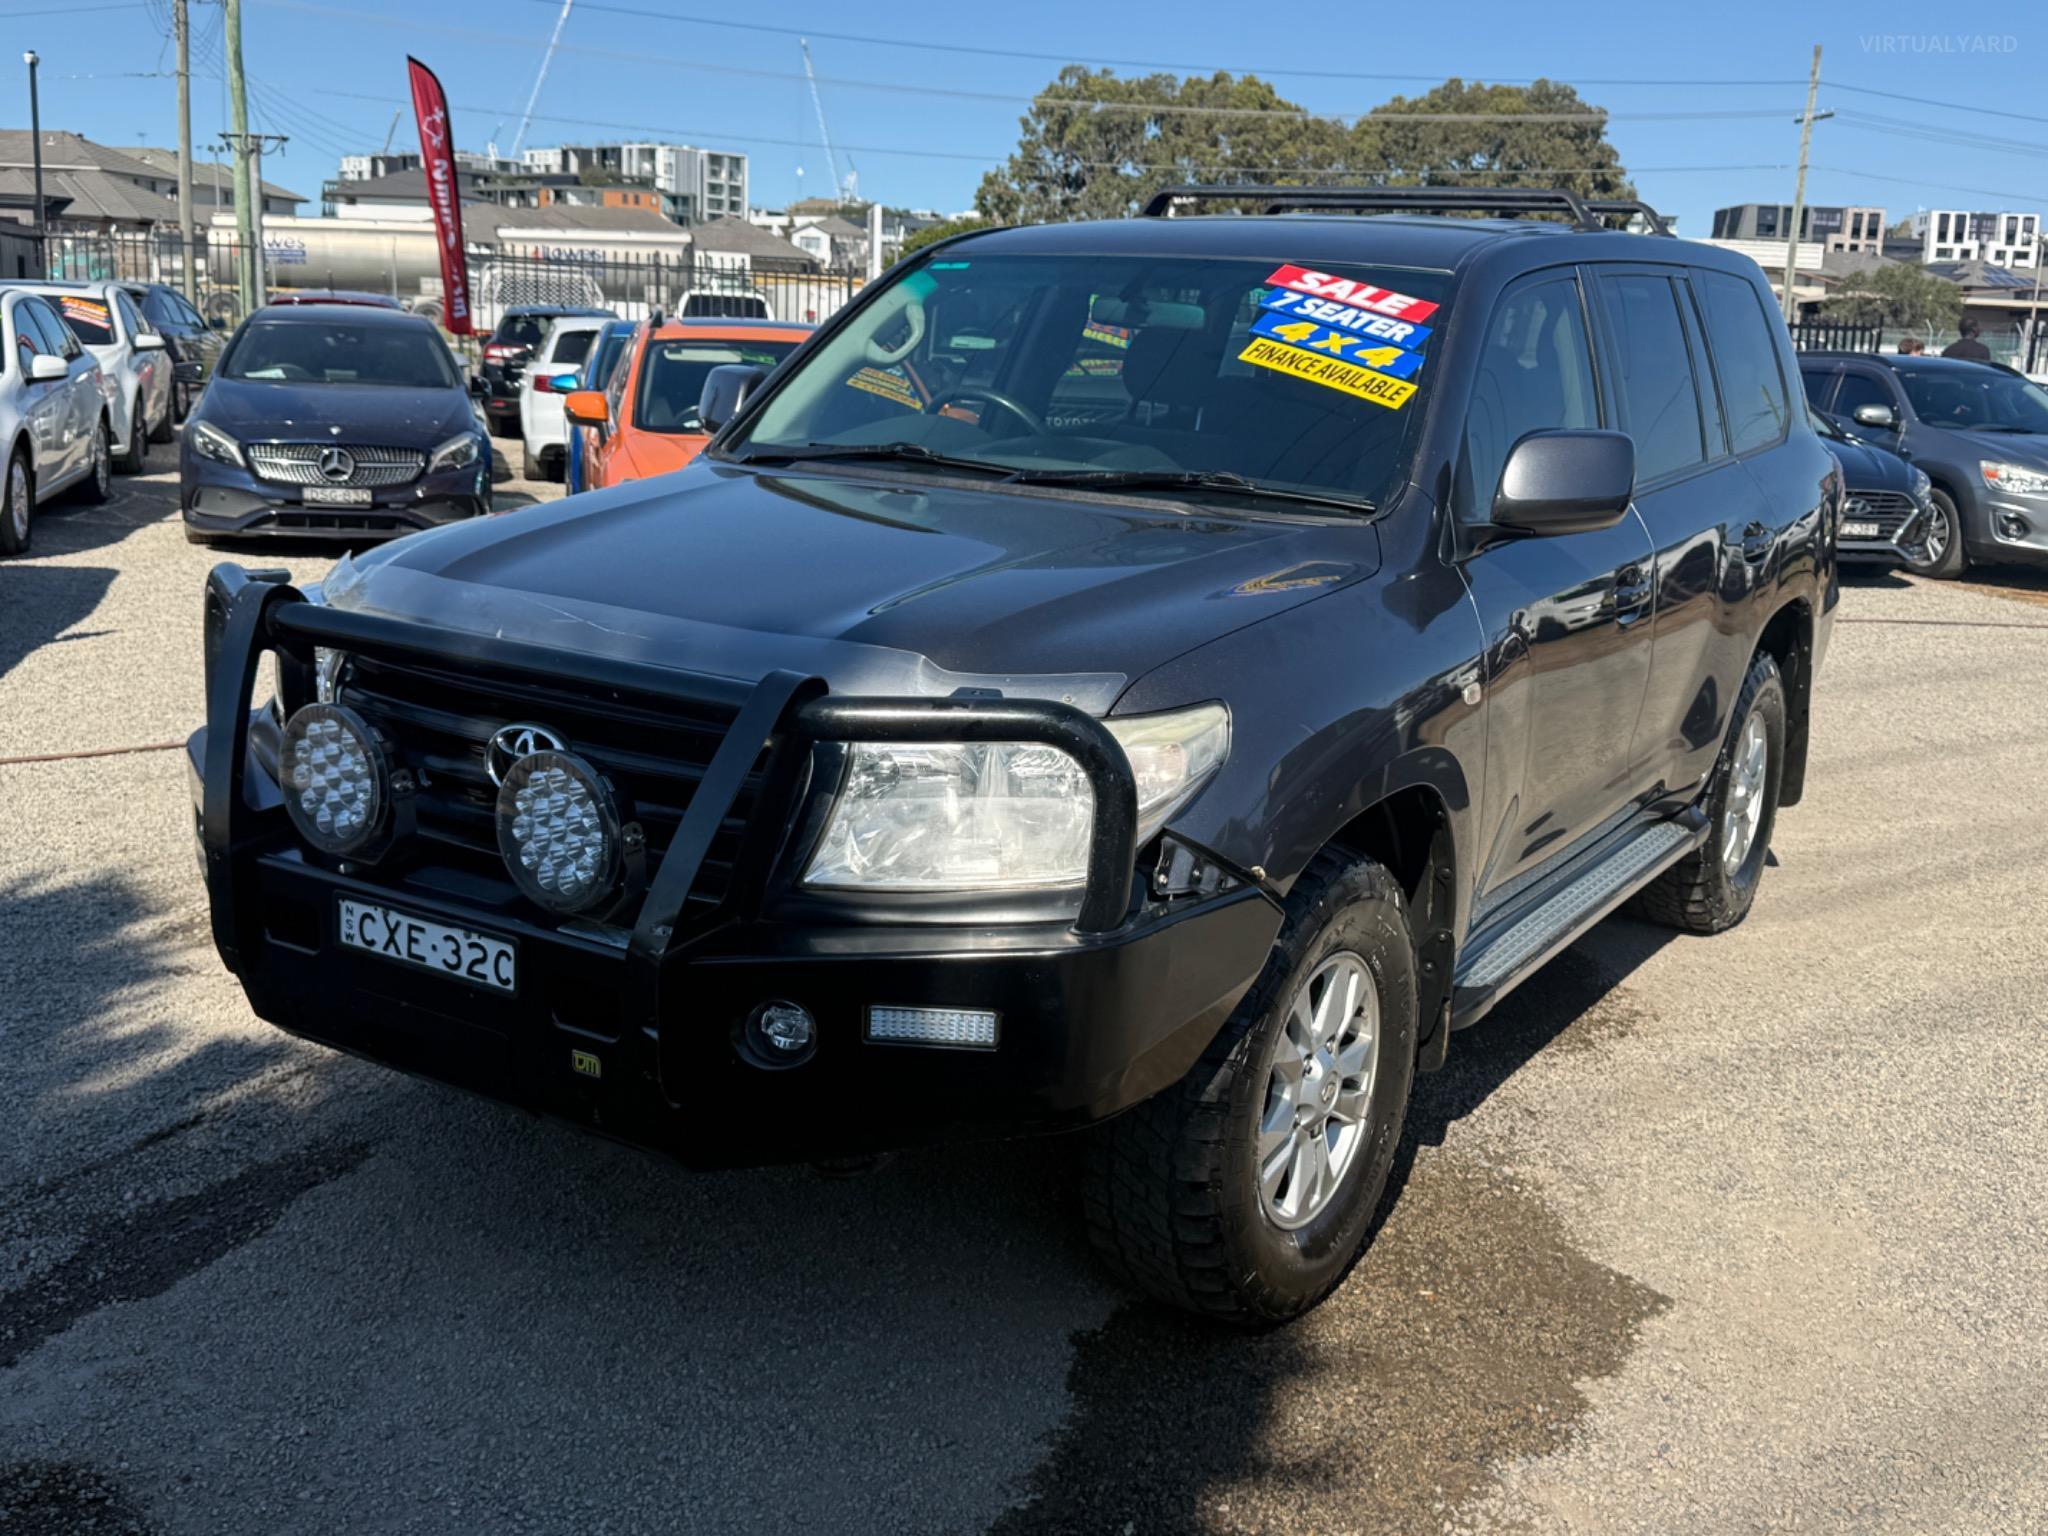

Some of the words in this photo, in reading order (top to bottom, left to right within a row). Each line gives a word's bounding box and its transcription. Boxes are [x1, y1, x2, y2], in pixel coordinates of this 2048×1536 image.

[1269, 291, 1303, 307] 7
[1294, 299, 1415, 342] SEATER
[1289, 272, 1419, 314] SALE
[1247, 343, 1318, 372] FINANCE
[1313, 361, 1408, 402] AVAILABLE
